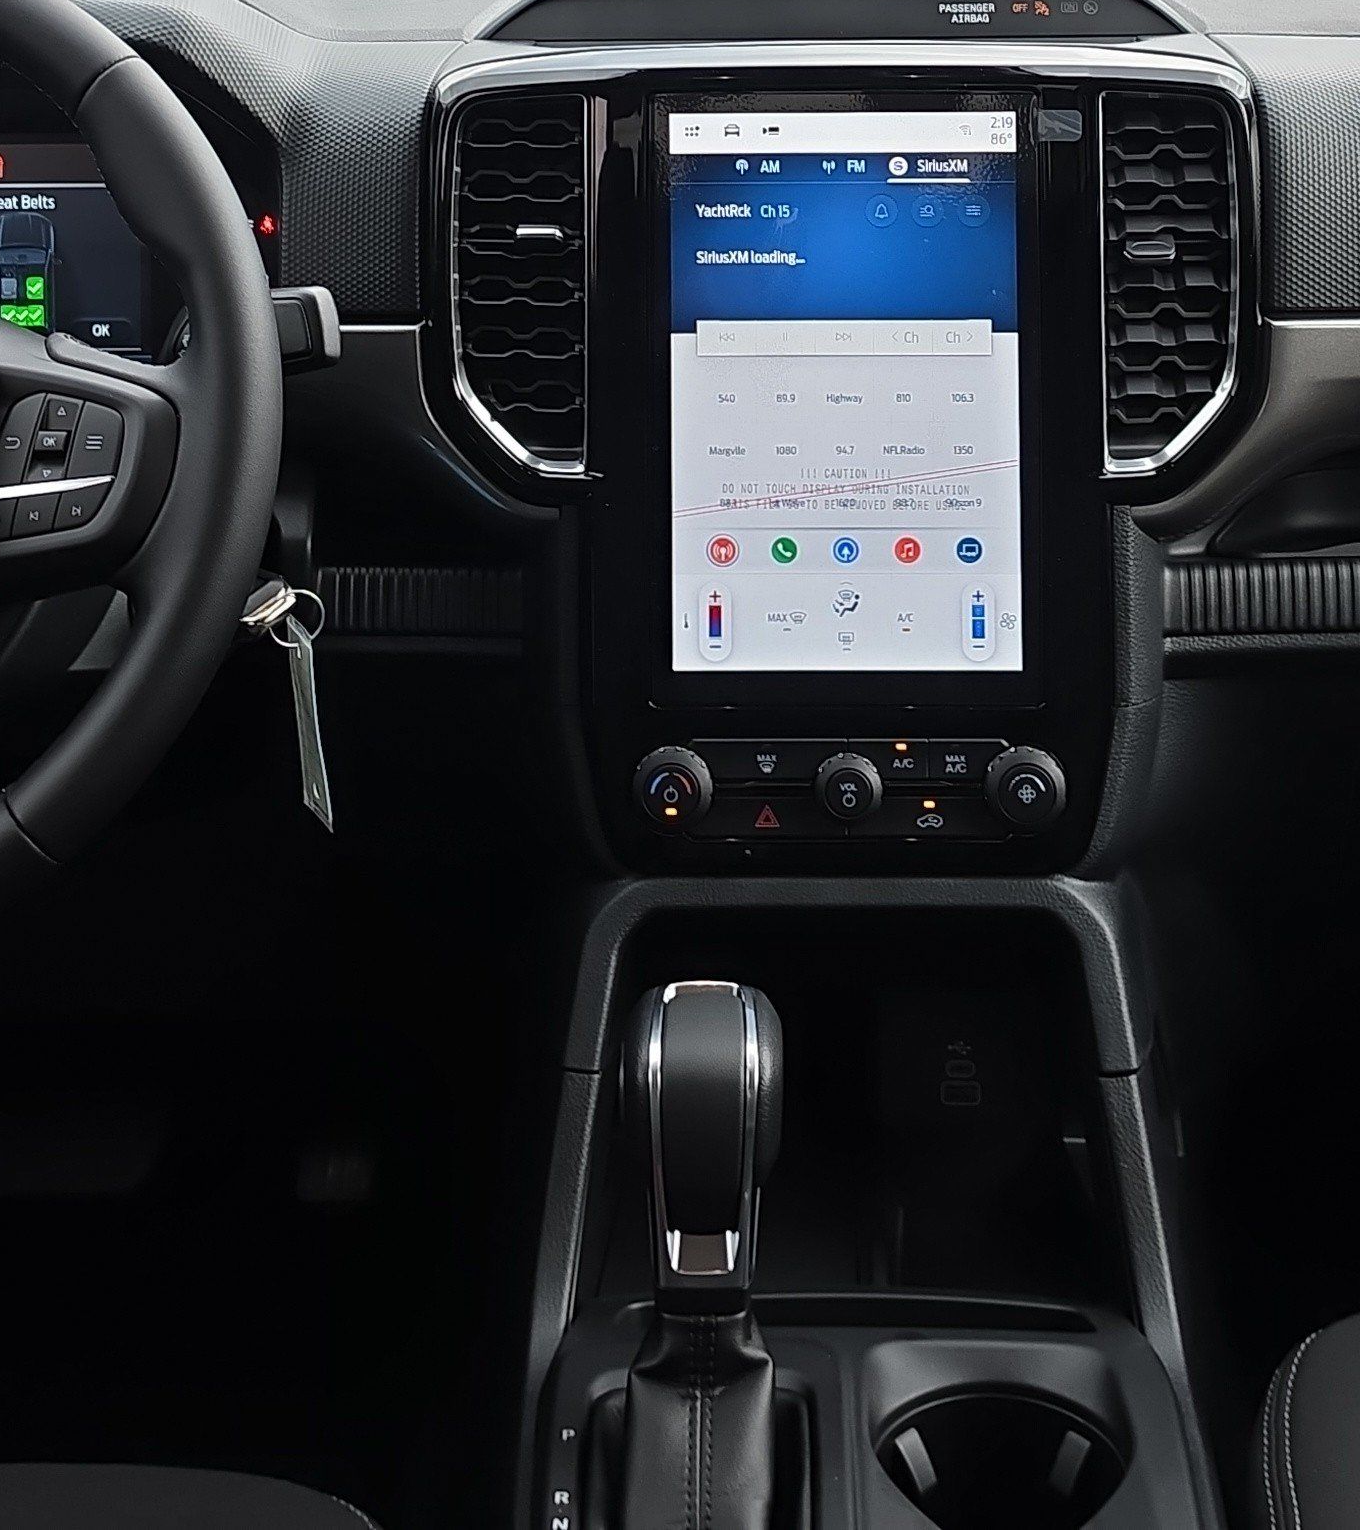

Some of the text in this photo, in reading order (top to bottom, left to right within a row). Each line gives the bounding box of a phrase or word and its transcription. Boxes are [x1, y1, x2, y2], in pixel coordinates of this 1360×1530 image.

[938, 3, 996, 14] PASSENGER
[1012, 3, 1029, 13] OFF
[951, 14, 990, 24] AIRBAG
[990, 116, 1014, 129] 2:19
[990, 133, 1013, 145] 86°
[760, 160, 780, 173] AM
[847, 160, 865, 173] FM
[916, 158, 968, 173] SiriusXM
[21, 194, 56, 210] Belts
[695, 203, 790, 218] YachtRck Ch 15
[695, 250, 749, 265] SiriusXM
[92, 323, 111, 337] OK
[904, 331, 961, 344] Ch Ch
[718, 393, 736, 404] 540
[826, 393, 863, 406] Highway
[896, 393, 911, 403] 810
[951, 392, 975, 404] 106.3
[42, 437, 57, 447] OK
[775, 446, 797, 456] 1080
[835, 446, 855, 456] 94.7
[882, 445, 926, 456] NFLRadio
[953, 445, 974, 456] 1350
[824, 468, 868, 479] CAUTION
[722, 483, 971, 496] DO NOT TOUCH DISPLAY DURING INSTALLATION
[767, 612, 914, 623] MAX A/C
[756, 754, 777, 763] MAX
[892, 758, 915, 769] A/C
[945, 754, 967, 763] MAX
[945, 762, 967, 773] A/C
[839, 783, 858, 792] VOL
[561, 1428, 576, 1442] P
[553, 1490, 571, 1506] R
[551, 1517, 570, 1530] N
